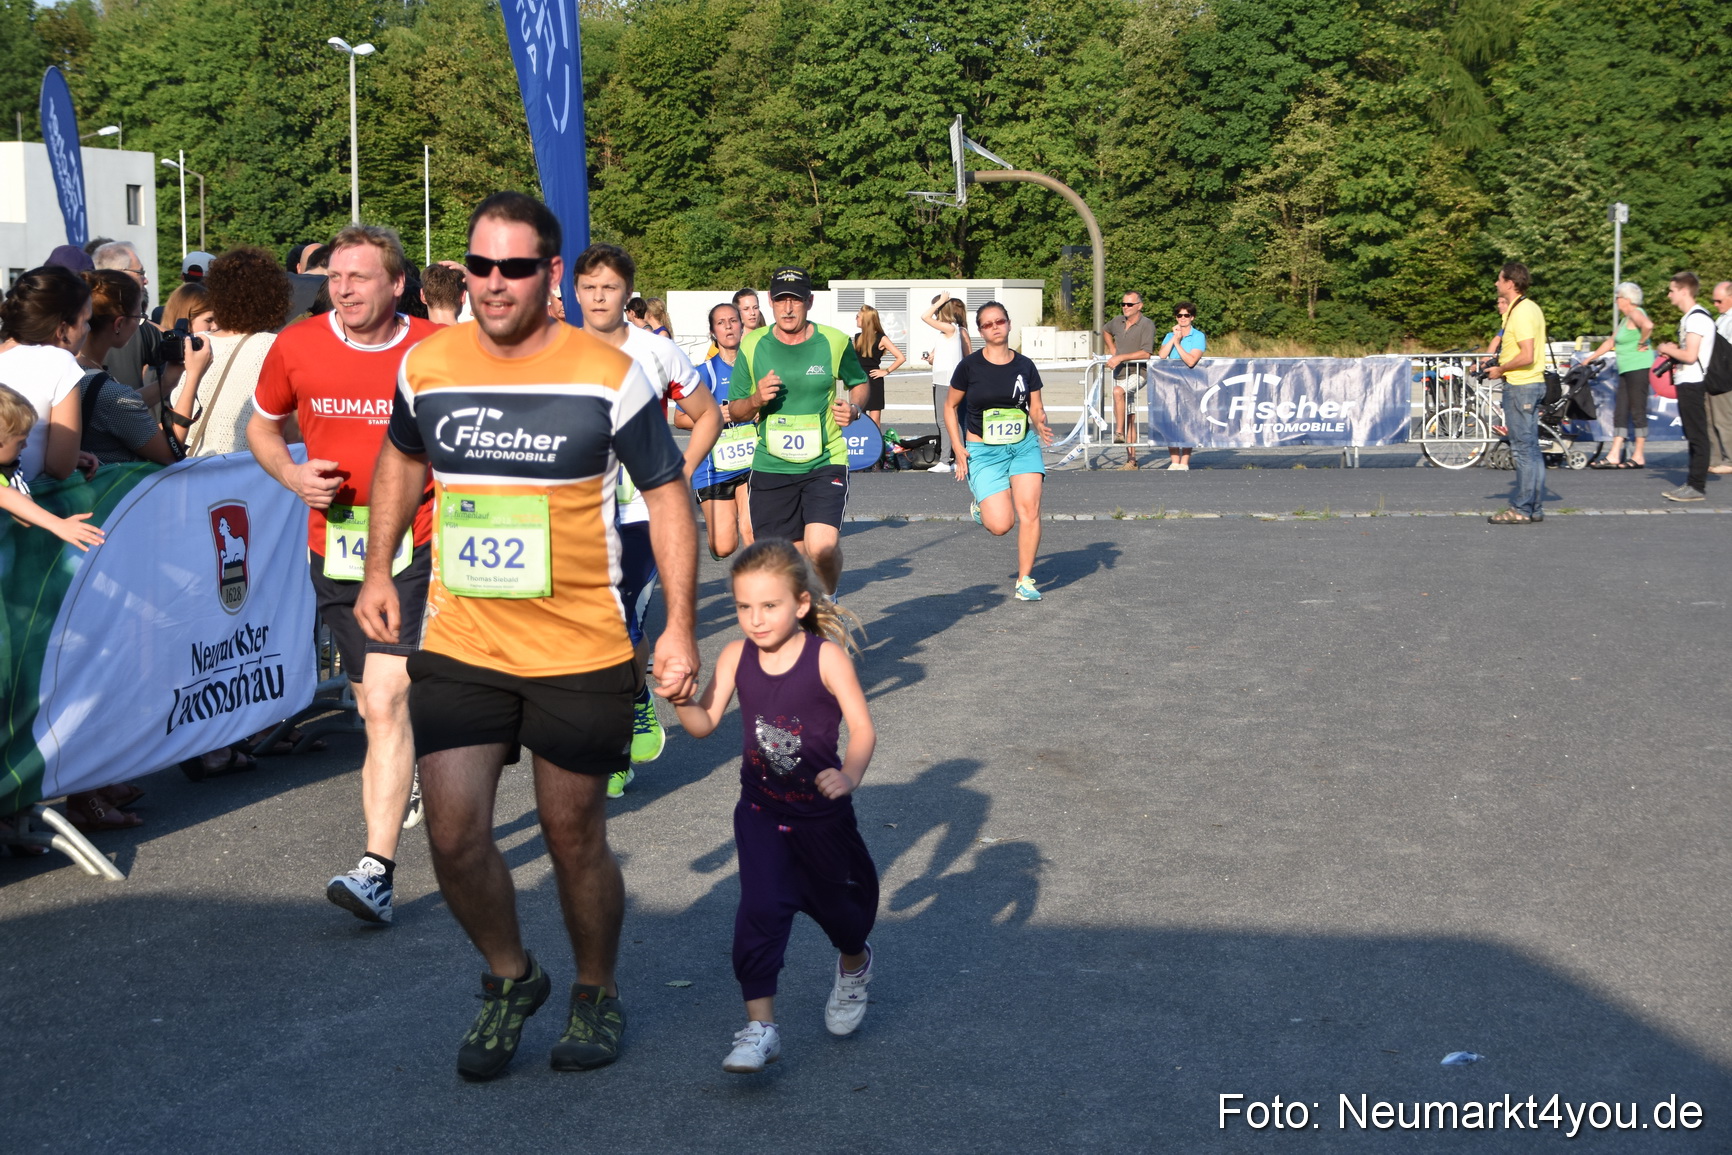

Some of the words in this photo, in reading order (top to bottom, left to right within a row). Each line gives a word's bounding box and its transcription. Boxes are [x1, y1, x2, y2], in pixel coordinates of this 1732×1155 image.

[806, 365, 825, 375] AOK
[1228, 395, 1356, 420] Fischer
[988, 422, 1022, 436] 1129
[1240, 422, 1345, 433] AUTOMOBILE
[454, 425, 567, 451] Fischer
[783, 434, 805, 450] 20
[464, 449, 557, 462] AUTOMOBILE
[717, 441, 755, 461] 1355
[458, 535, 525, 569] 432
[466, 574, 492, 582] Thomas
[225, 586, 242, 604] 1628
